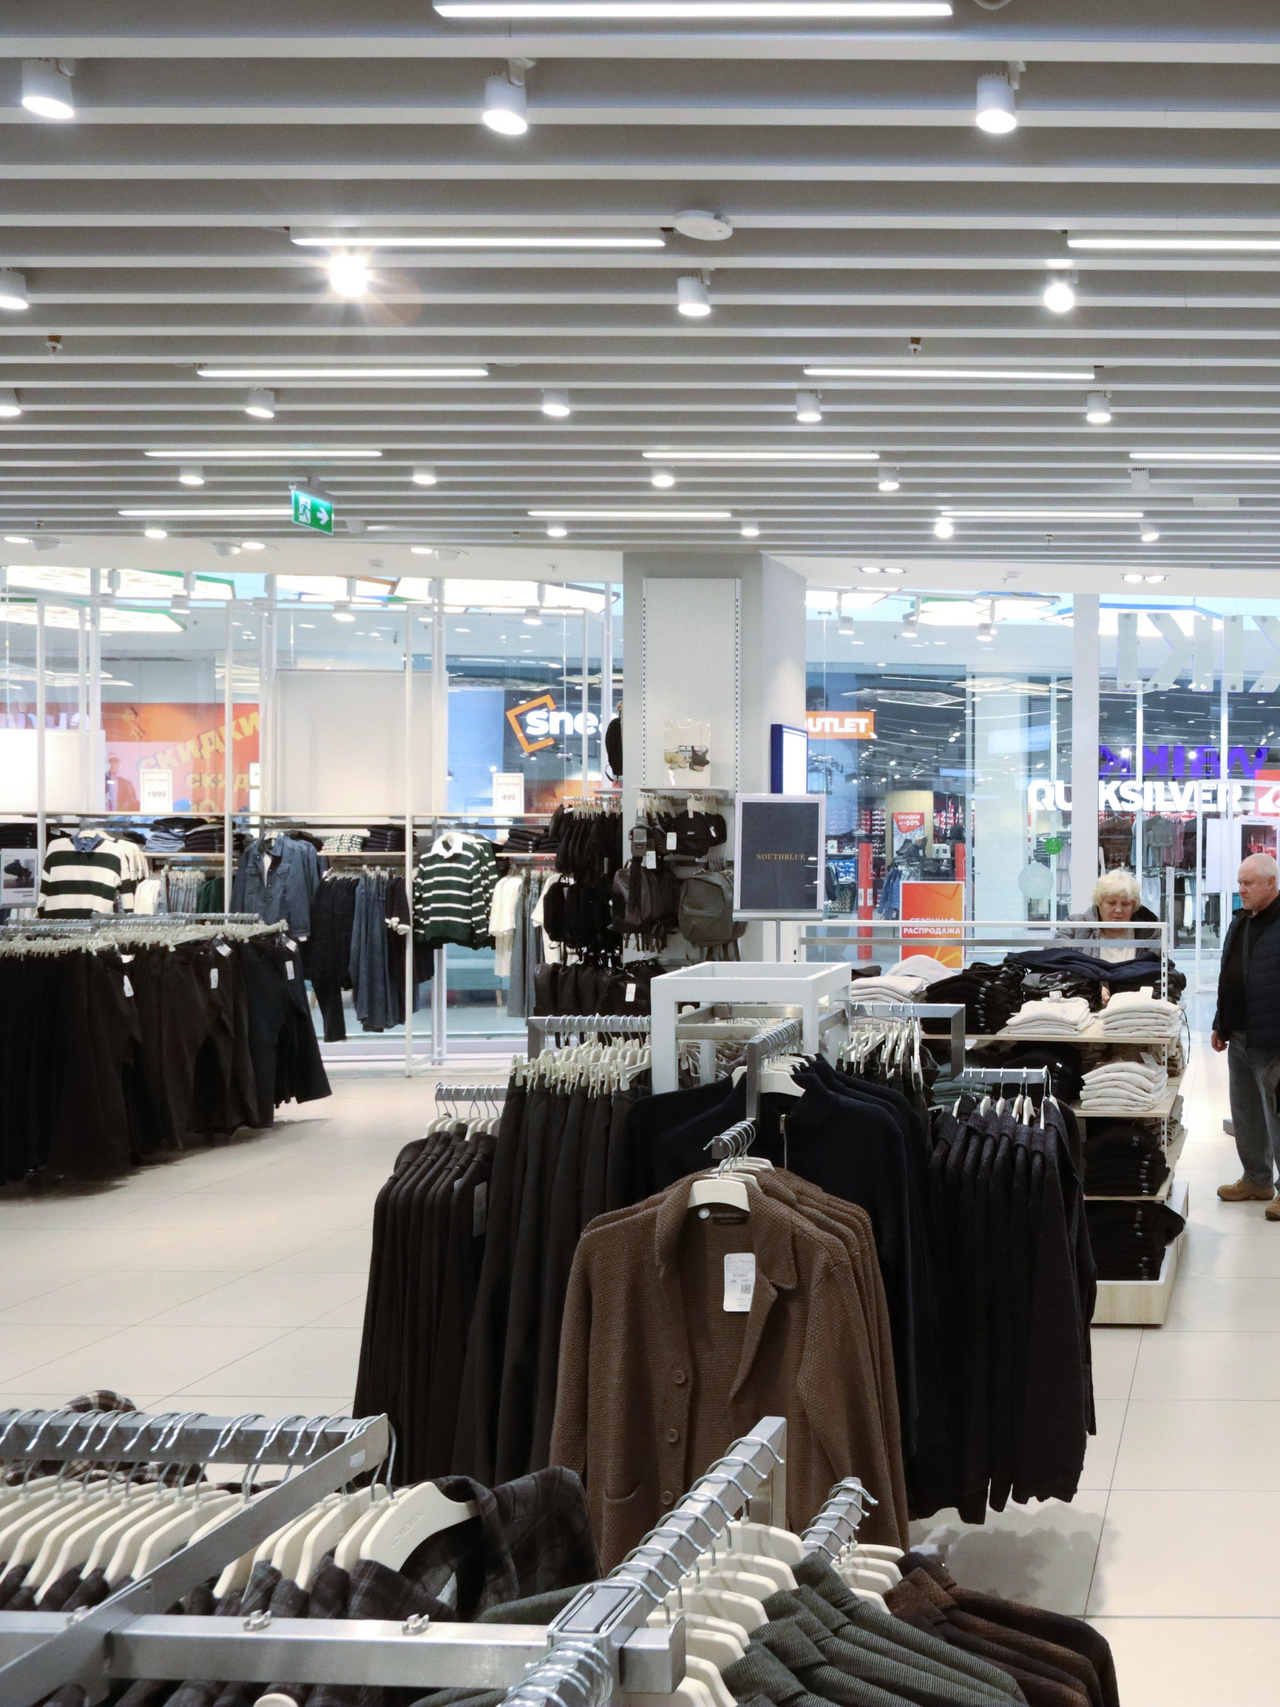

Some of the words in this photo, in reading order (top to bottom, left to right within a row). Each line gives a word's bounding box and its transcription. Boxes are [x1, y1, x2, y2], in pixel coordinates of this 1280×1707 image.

[805, 718, 869, 733] UTLET
[147, 790, 167, 798] 1999
[1027, 779, 1243, 812] QUKSILVER
[756, 853, 806, 861] SOUTHBLUE
[903, 927, 961, 935] РАСПРОДАЖА
